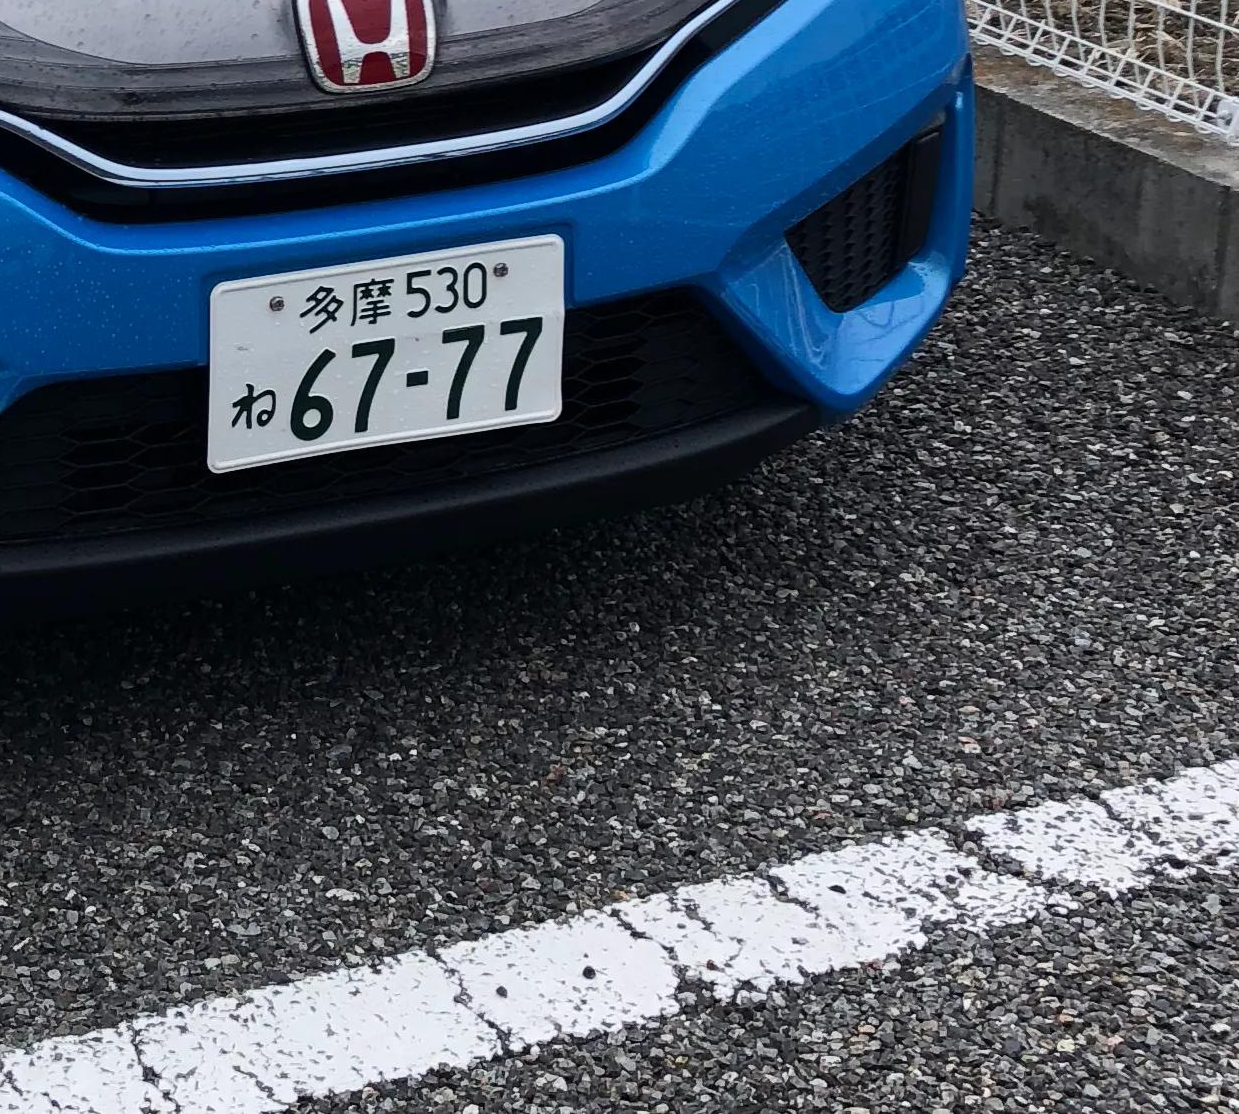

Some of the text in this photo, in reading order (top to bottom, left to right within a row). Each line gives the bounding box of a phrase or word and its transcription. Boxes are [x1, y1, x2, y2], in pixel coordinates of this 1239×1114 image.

[299, 262, 488, 334] 多摩 530
[231, 316, 543, 441] ね 67-77
